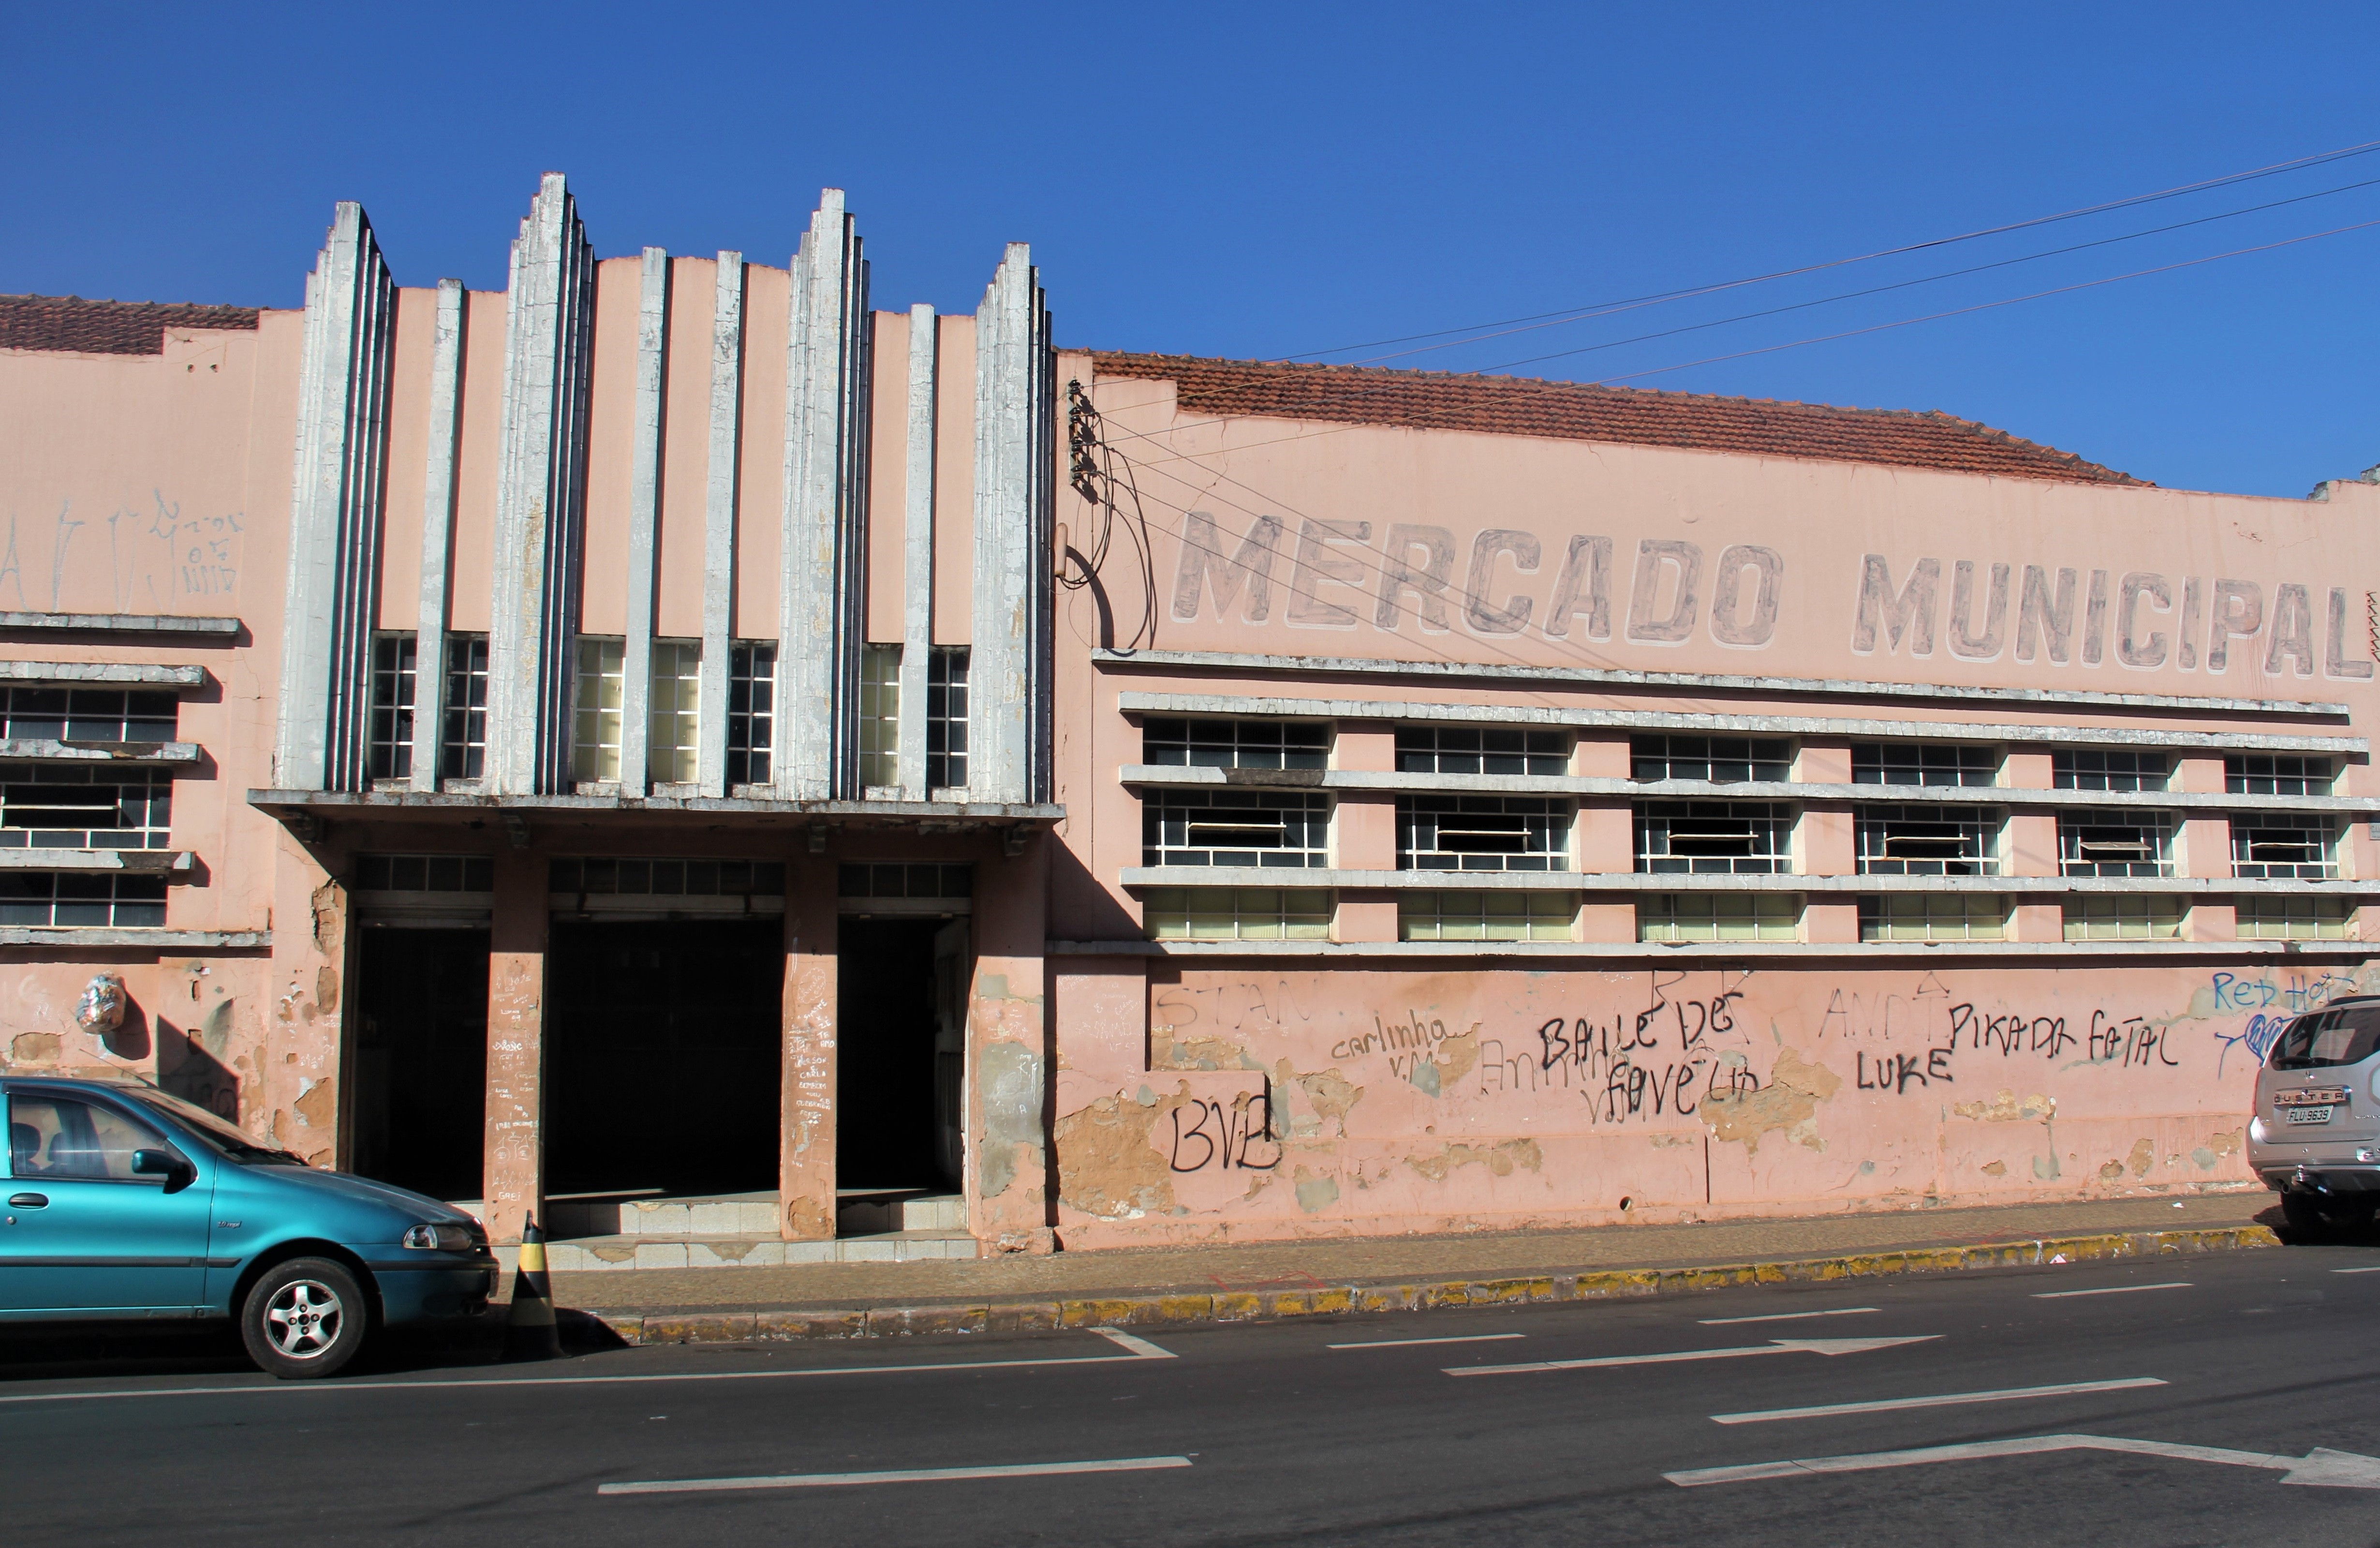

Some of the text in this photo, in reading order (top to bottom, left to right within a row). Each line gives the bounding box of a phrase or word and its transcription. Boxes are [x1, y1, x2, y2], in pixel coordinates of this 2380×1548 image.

[1169, 511, 2374, 682] MERCADO MUNICIPAL
[1857, 1048, 1953, 1095] LUKE
[2274, 1092, 2344, 1103] DUSTER
